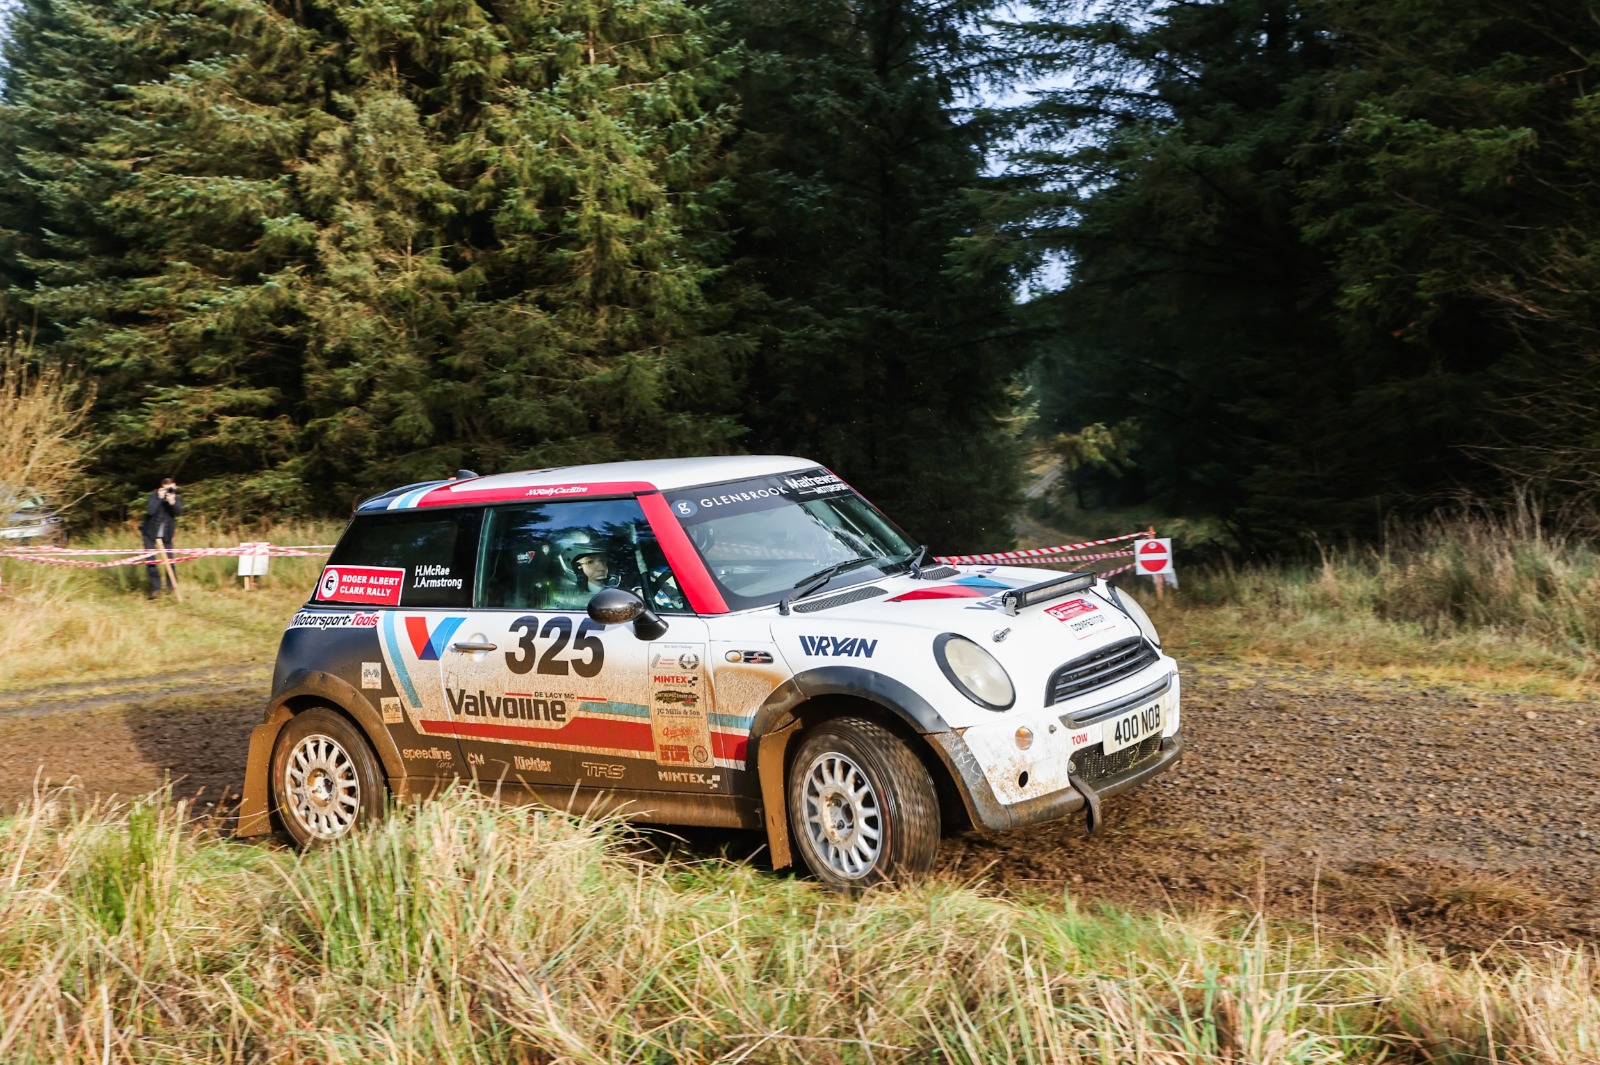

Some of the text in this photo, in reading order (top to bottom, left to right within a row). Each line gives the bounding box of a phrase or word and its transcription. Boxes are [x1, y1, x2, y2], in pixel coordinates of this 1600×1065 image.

[700, 486, 789, 508] GLENBROOK
[414, 565, 450, 577] H.McRae
[341, 574, 400, 586] ROGER ALBERT
[413, 577, 463, 589] J.Armstrong
[339, 586, 392, 597] CLARK RALLY
[504, 615, 605, 678] 325
[653, 675, 687, 684] MINTEX
[1114, 703, 1161, 746] 400 NOB
[1071, 733, 1088, 745] TOW
[402, 747, 452, 761] speedline
[581, 761, 626, 780] TRS
[657, 770, 706, 784] MINTEX
